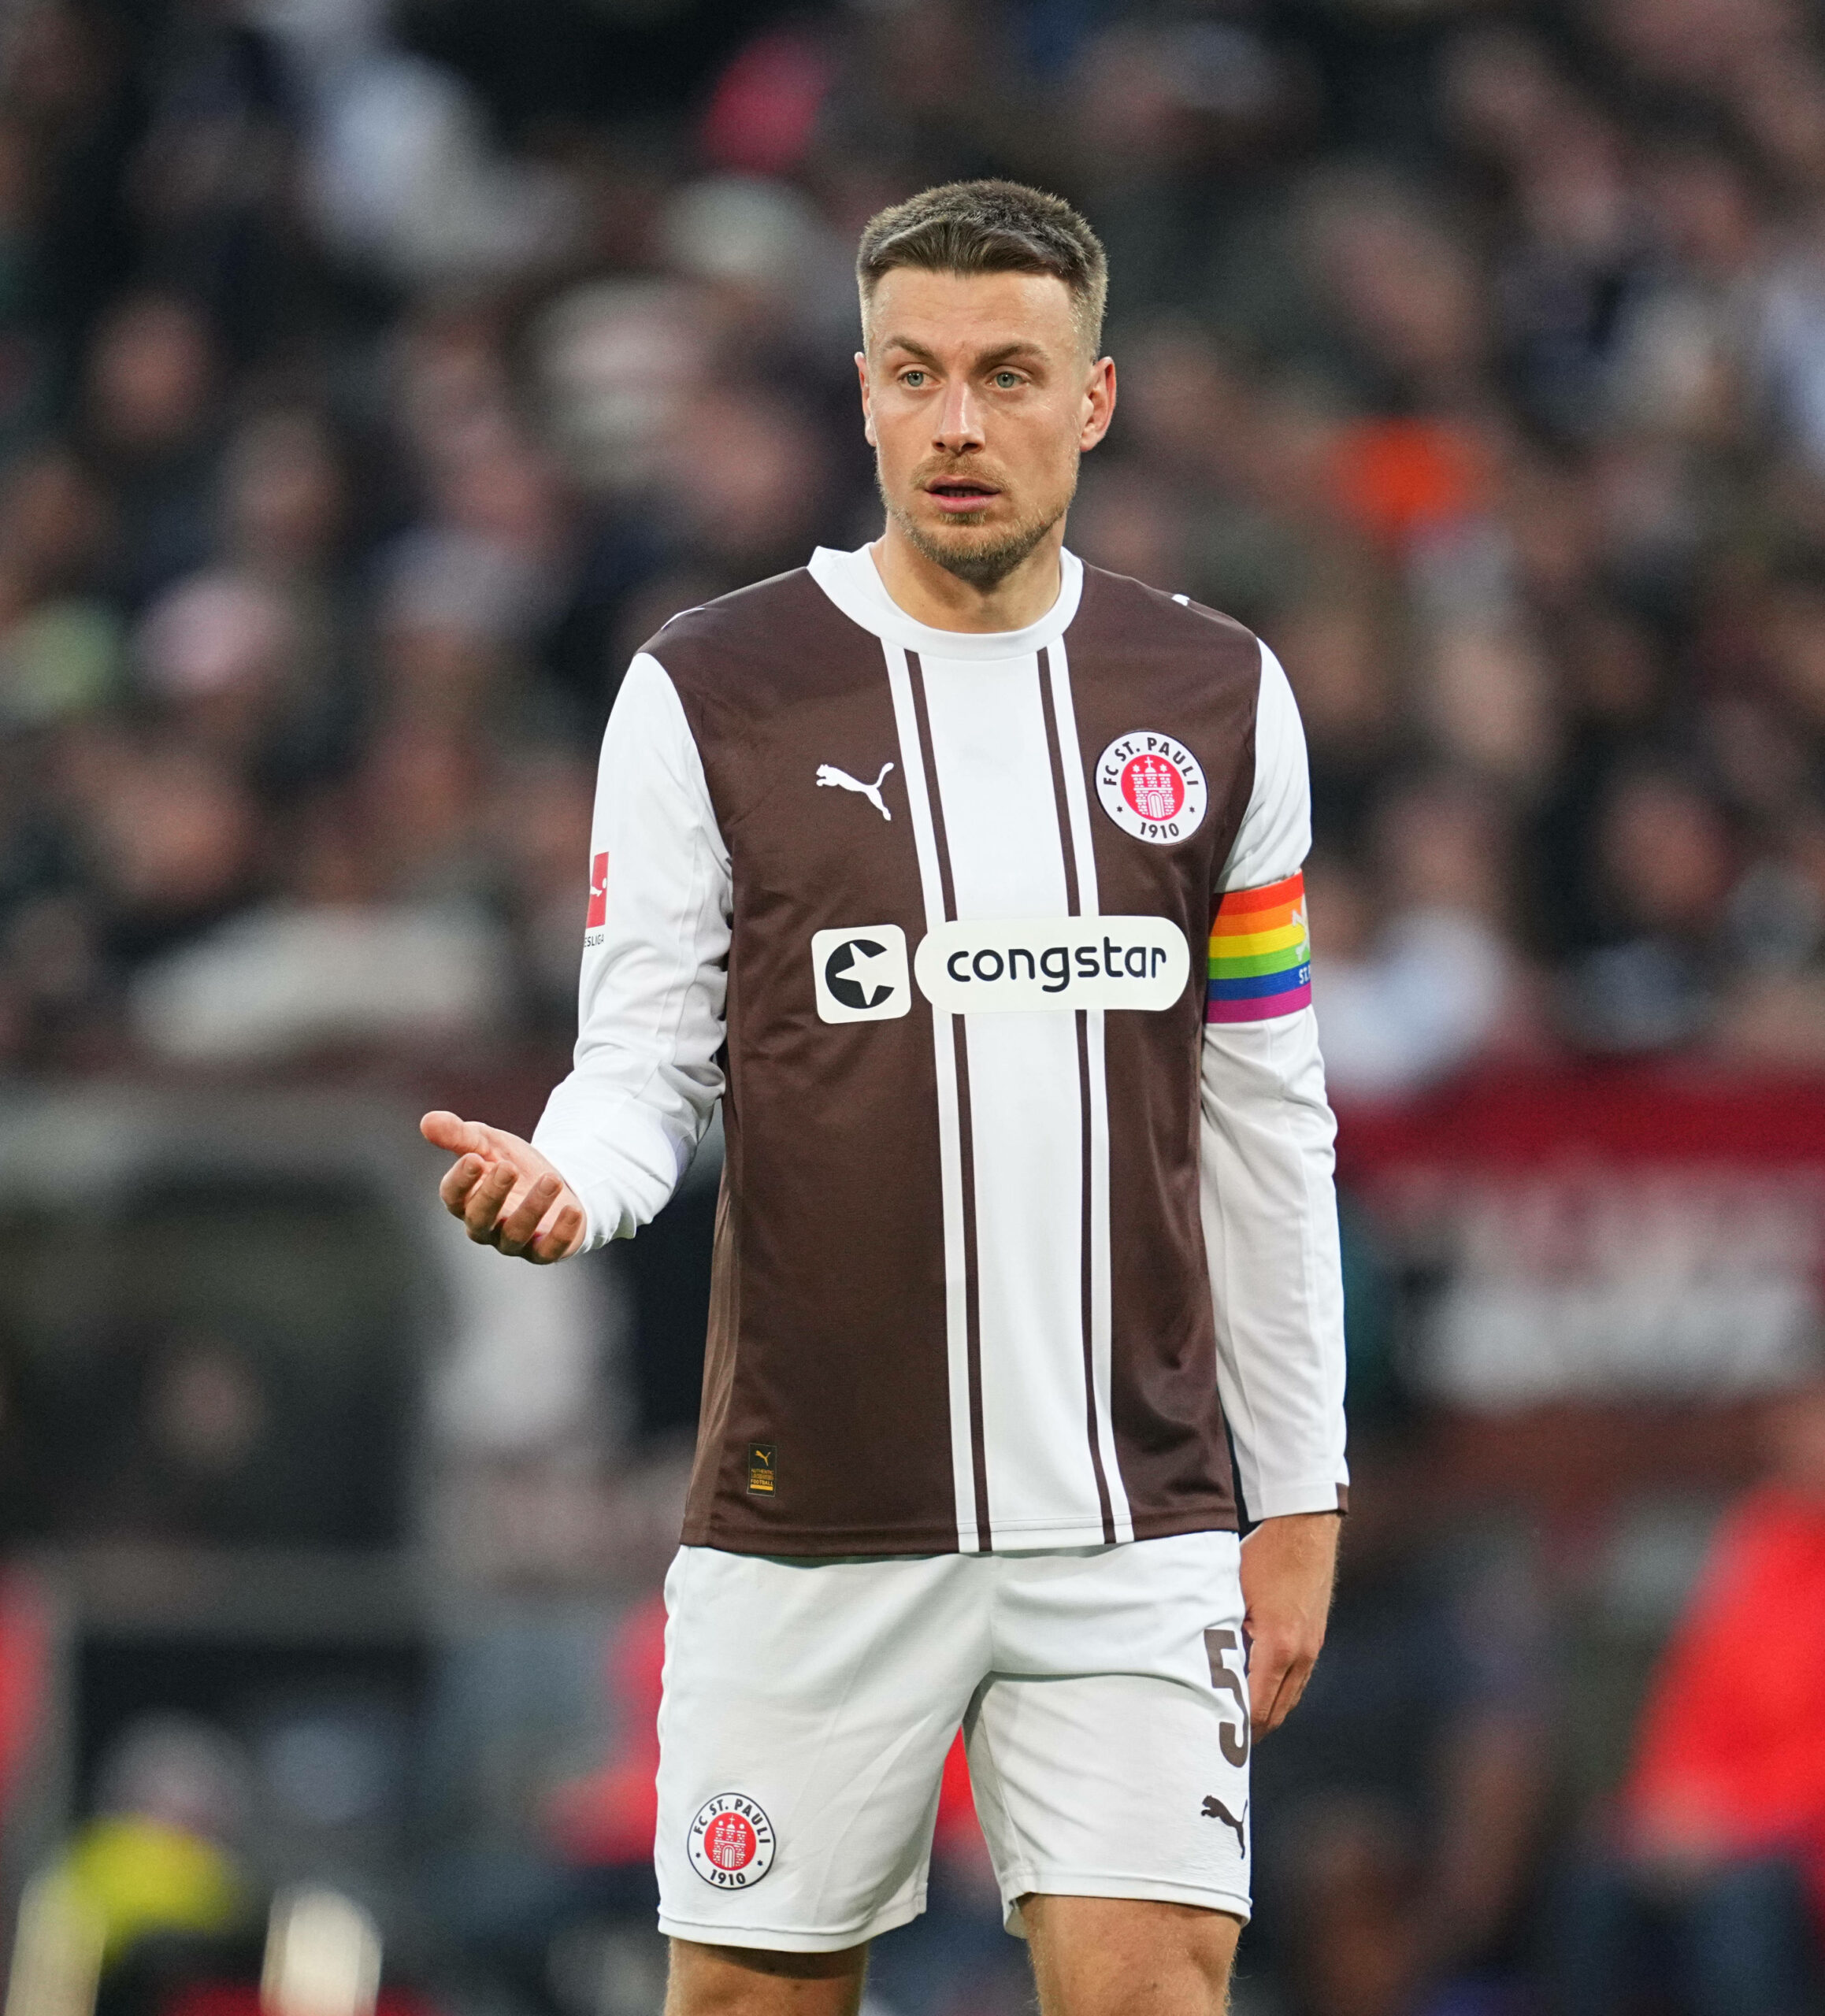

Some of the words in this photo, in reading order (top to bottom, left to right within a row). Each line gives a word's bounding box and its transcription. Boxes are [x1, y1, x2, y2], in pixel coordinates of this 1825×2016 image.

[1103, 765, 1119, 786] FC
[1115, 740, 1141, 762] ST.
[1147, 736, 1200, 786] PAULI
[1140, 821, 1180, 839] 1910
[947, 936, 1167, 993] congstar
[1204, 1629, 1249, 1768] 5
[693, 1815, 708, 1835] FC
[709, 1798, 729, 1816] ST.
[734, 1798, 771, 1844] PAULI
[710, 1869, 746, 1886] 1910
